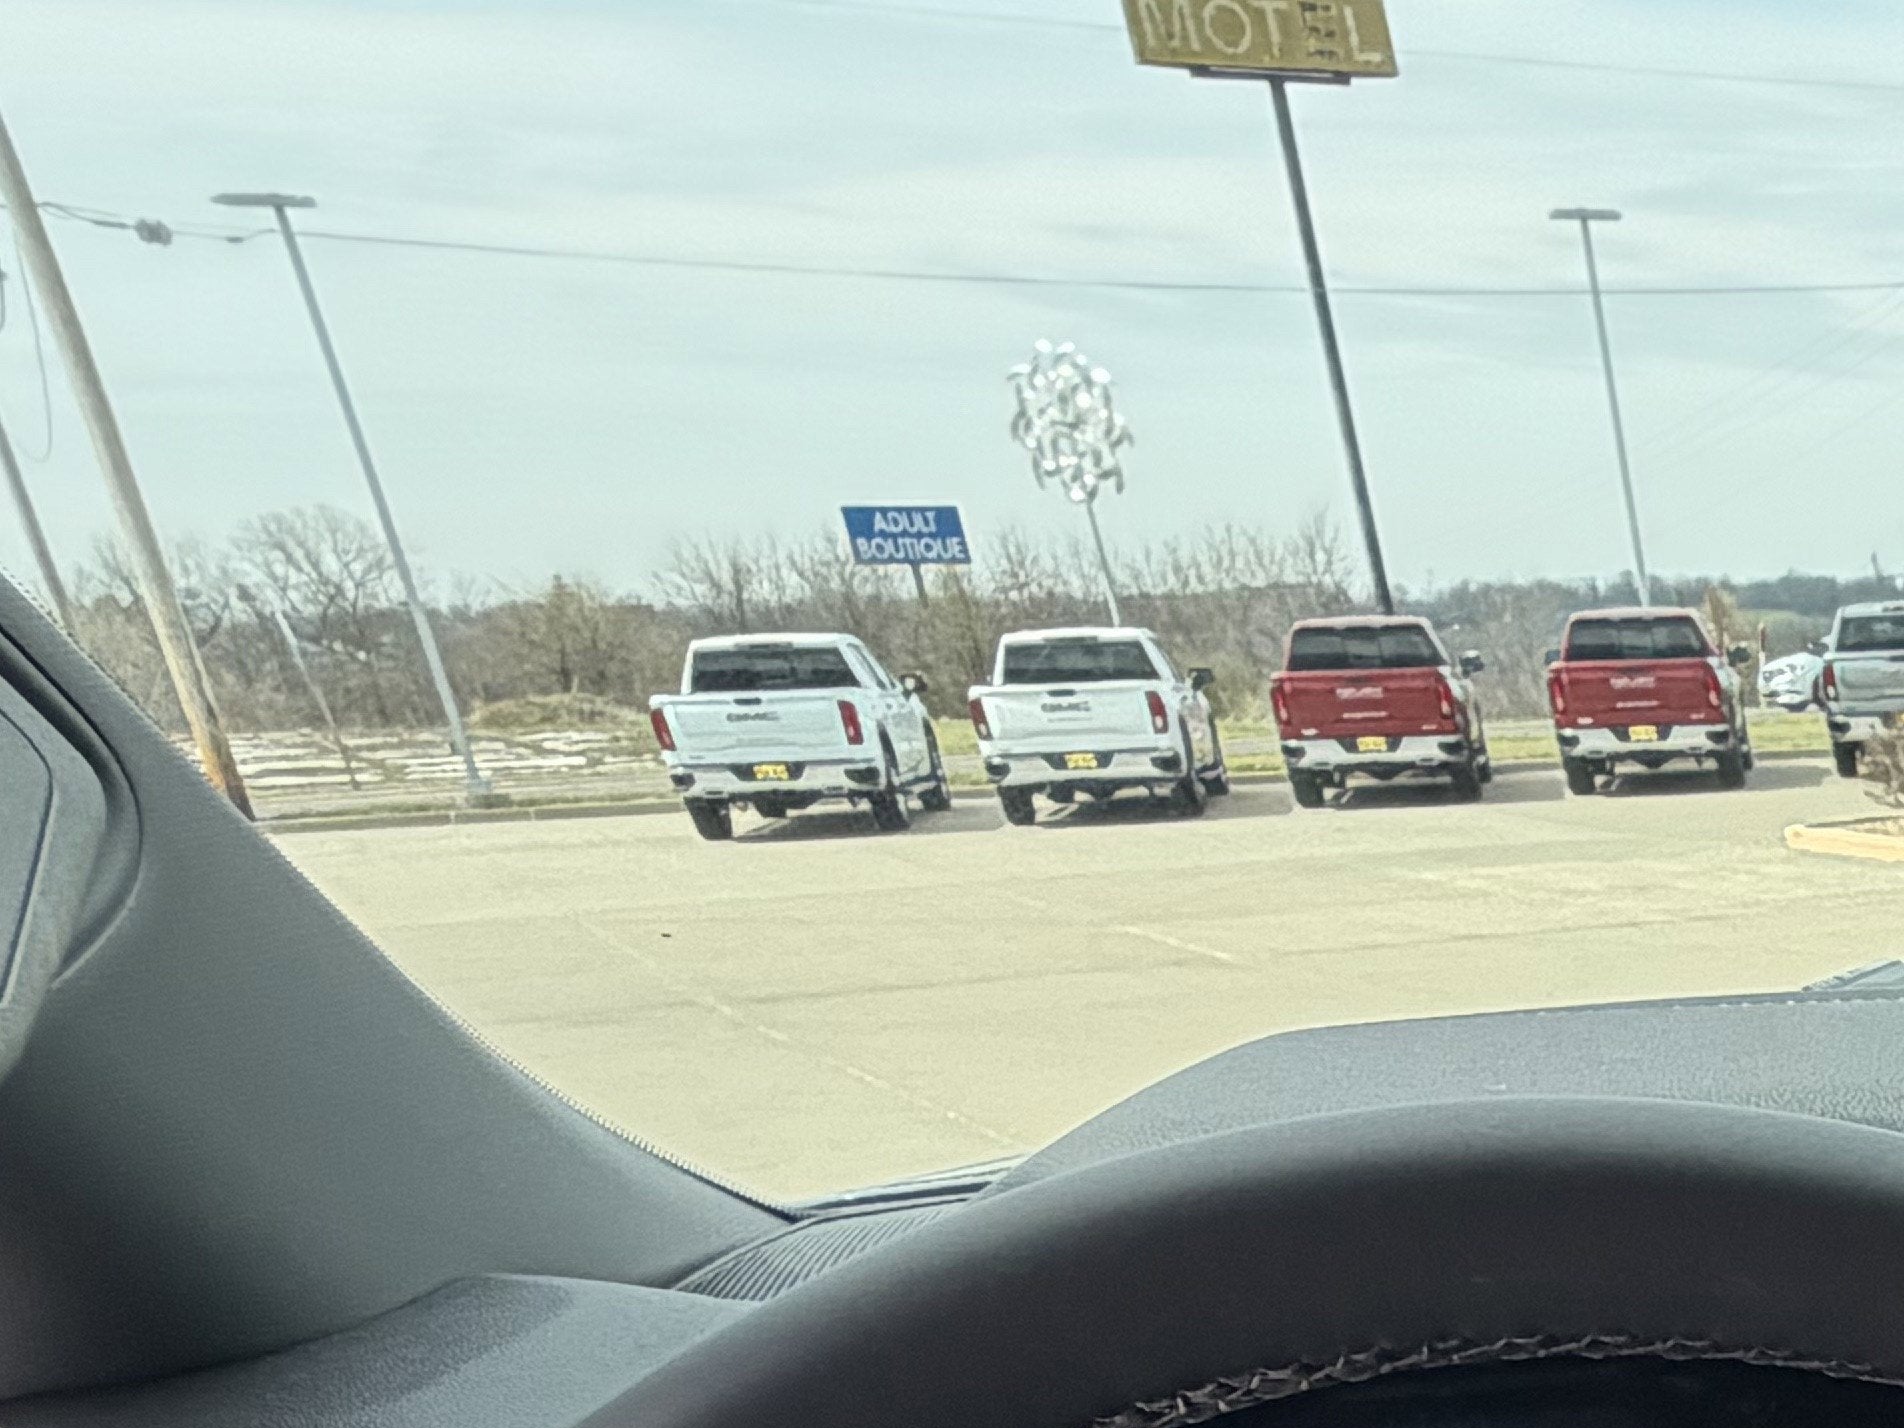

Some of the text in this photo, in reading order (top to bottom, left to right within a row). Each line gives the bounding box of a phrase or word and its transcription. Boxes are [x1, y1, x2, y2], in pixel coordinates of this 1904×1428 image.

[1137, 0, 1384, 62] MOTEL
[874, 510, 938, 534] ADULT
[856, 537, 966, 561] BOUTIQUE
